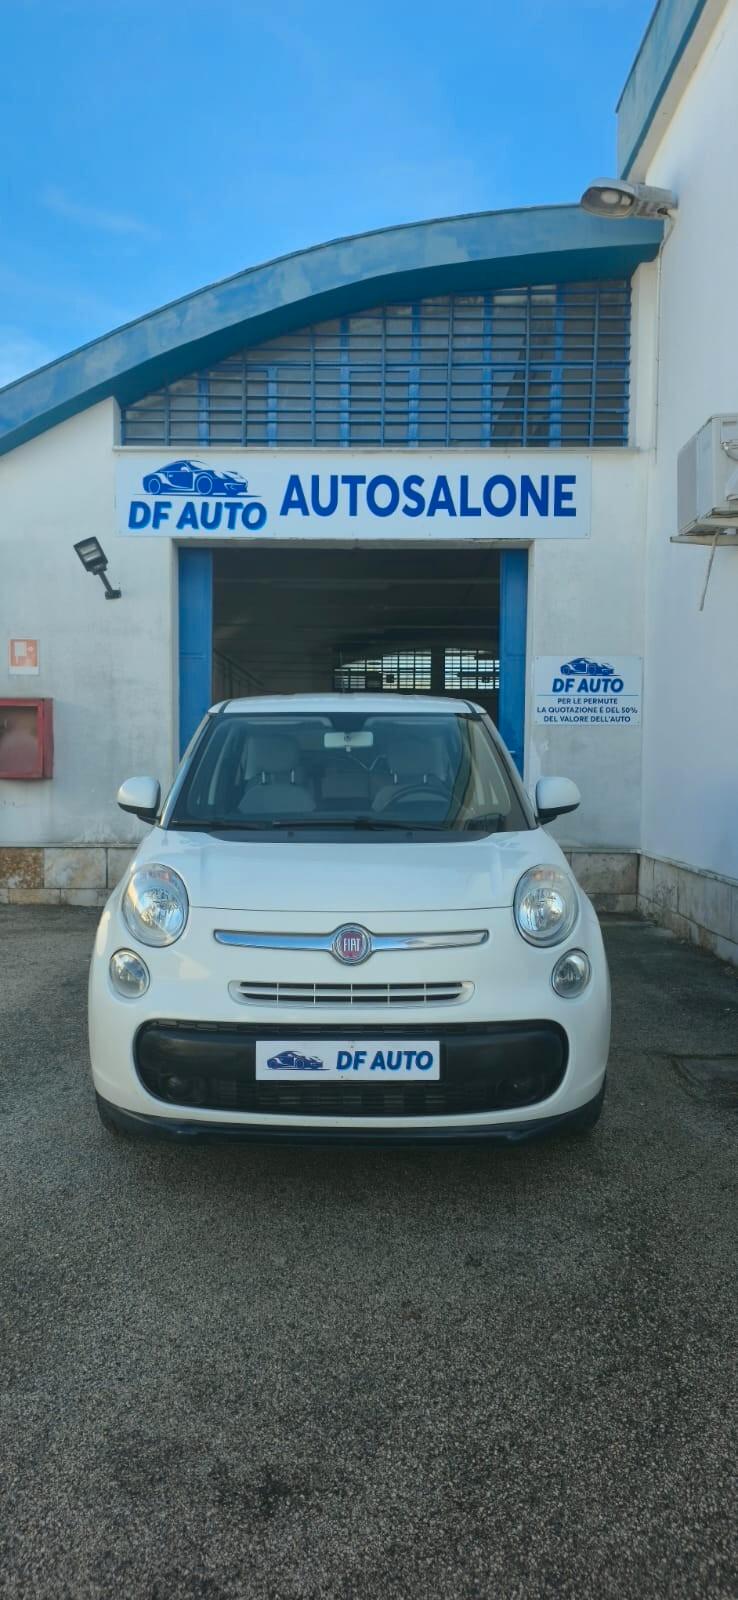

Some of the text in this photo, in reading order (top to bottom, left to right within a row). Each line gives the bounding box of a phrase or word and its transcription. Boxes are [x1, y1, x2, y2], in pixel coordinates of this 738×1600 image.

[280, 474, 577, 518] AUTOSALONE
[128, 500, 268, 530] DF AUTO
[552, 678, 624, 693] DF AUTO
[557, 697, 618, 705] PER LE PERMUTE
[536, 706, 547, 714] LA
[548, 706, 597, 714] QUOTAZIONE
[605, 706, 619, 714] DEL
[621, 706, 638, 714] 50%
[543, 715, 631, 723] DEL VALORE DELL'AUTO
[343, 937, 361, 952] FIAT
[336, 1050, 434, 1071] DF AUTO
